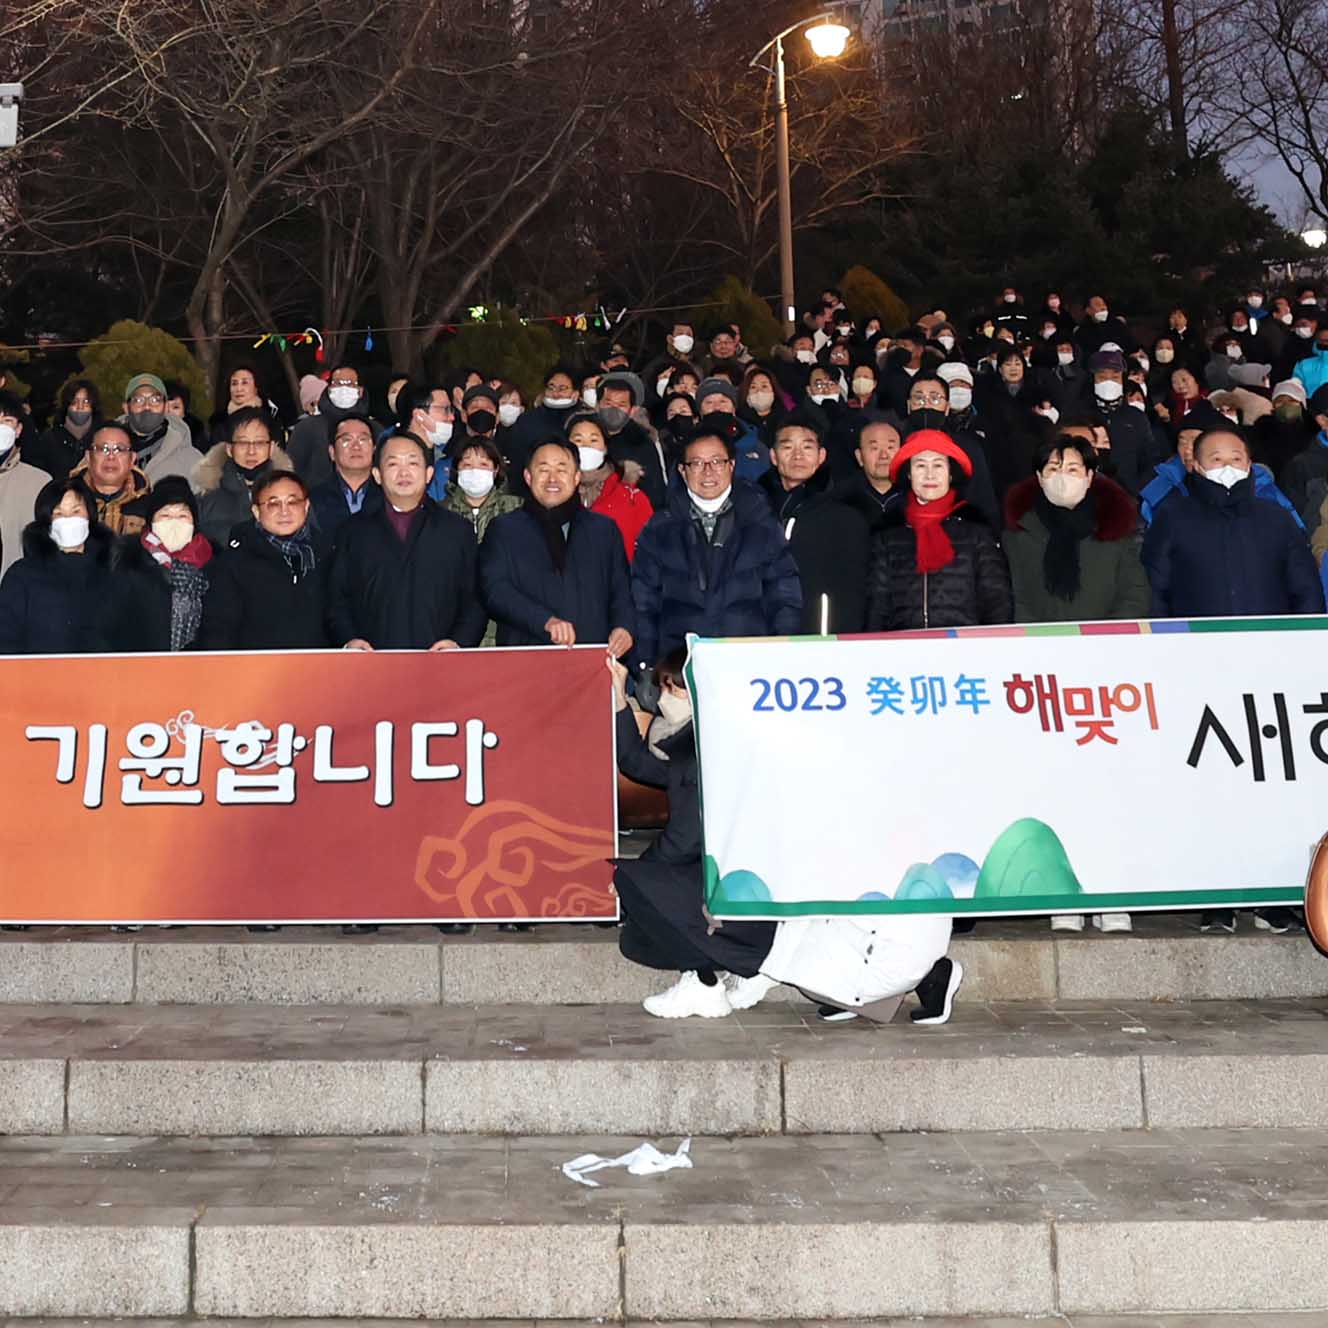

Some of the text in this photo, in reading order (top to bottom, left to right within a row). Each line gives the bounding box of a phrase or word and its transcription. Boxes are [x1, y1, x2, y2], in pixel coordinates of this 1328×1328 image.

[749, 672, 1160, 746] 2023 癸卯年 해맞이
[25, 716, 498, 809] 기원합니다
